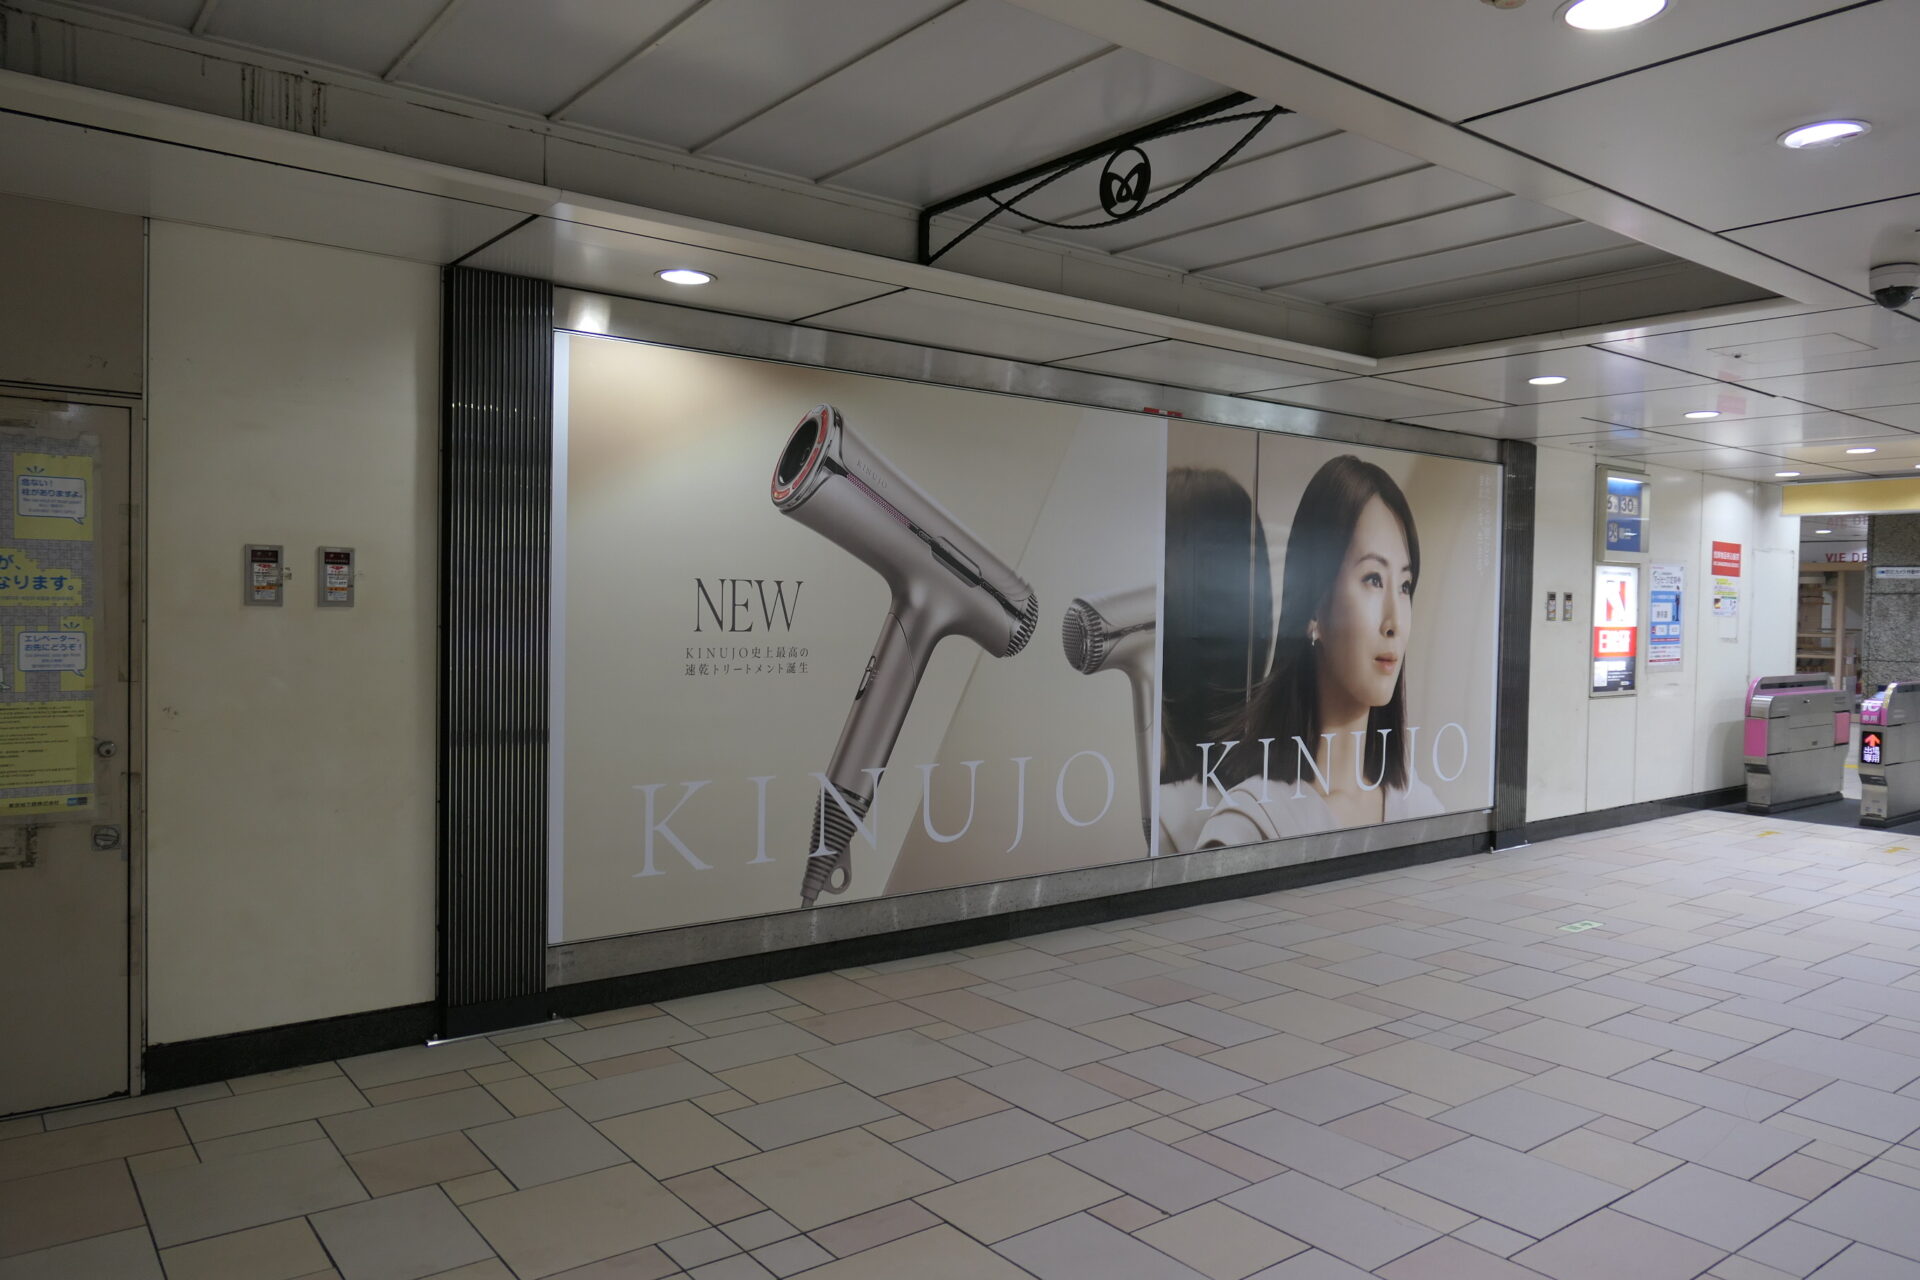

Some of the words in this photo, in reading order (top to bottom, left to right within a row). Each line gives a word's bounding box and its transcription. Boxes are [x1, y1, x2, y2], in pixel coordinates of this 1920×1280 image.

[1825, 552, 1846, 563] VIE
[694, 578, 804, 632] NEW
[685, 662, 809, 676] 速乾トリートメント誕生
[686, 646, 809, 660] KINUJO史上最高の
[1196, 722, 1469, 811] KINUJO
[632, 750, 1116, 878] KINUJO
